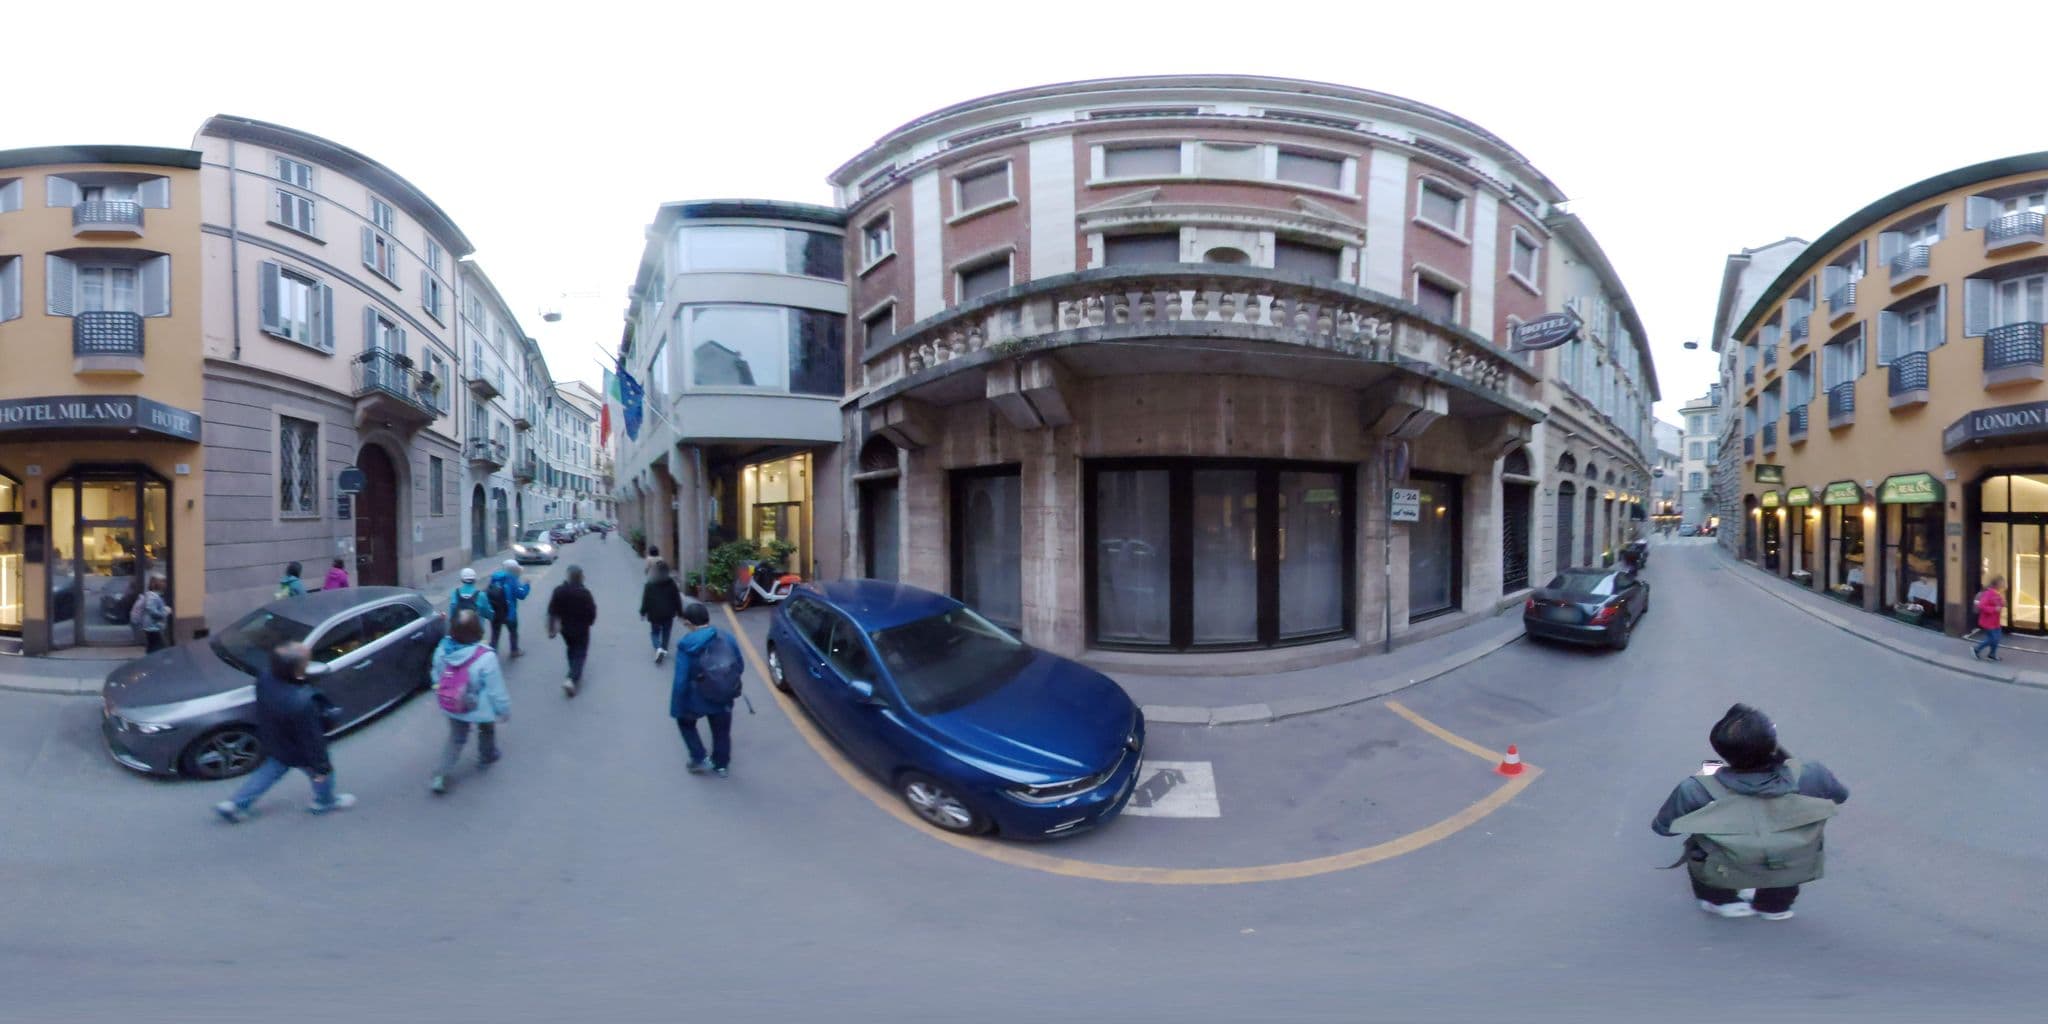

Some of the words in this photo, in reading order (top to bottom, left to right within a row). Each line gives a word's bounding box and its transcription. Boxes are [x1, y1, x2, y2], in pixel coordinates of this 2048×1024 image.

[1520, 317, 1569, 336] HOTEL
[59, 403, 133, 420] MILANO
[152, 408, 193, 434] HOTEL
[1975, 409, 2042, 431] LONDON
